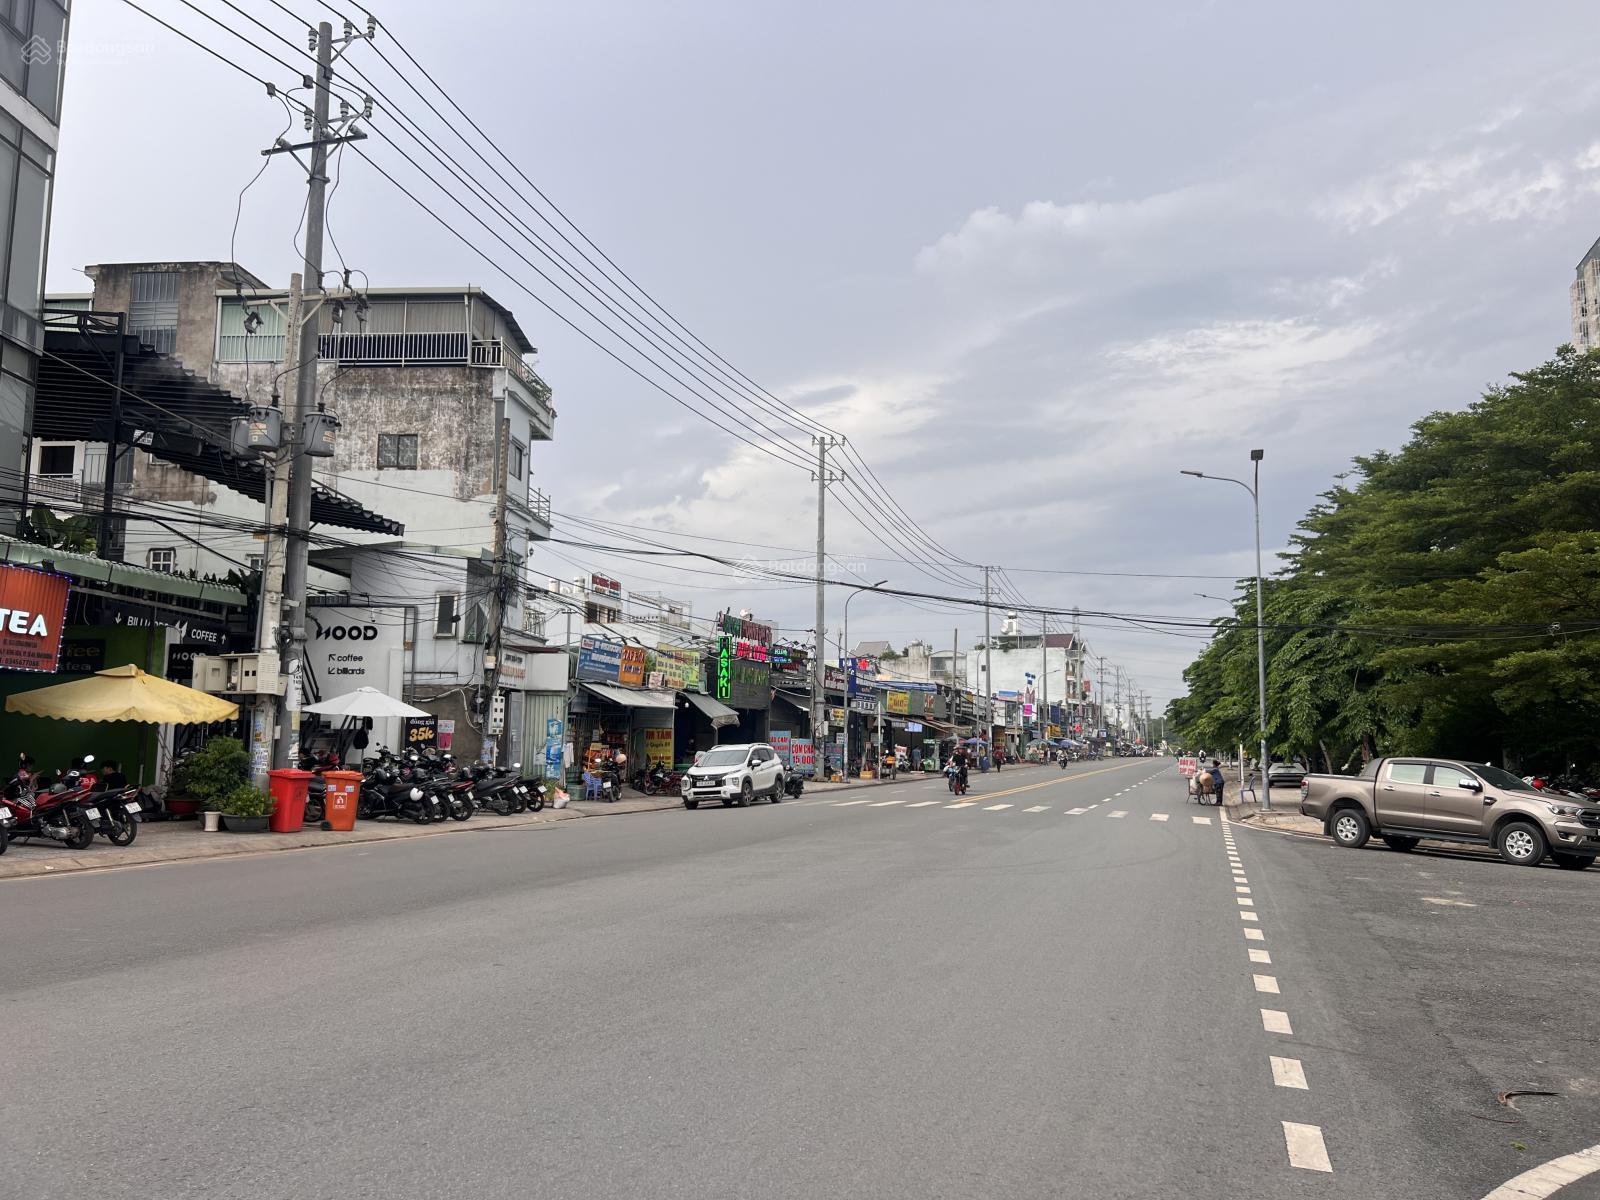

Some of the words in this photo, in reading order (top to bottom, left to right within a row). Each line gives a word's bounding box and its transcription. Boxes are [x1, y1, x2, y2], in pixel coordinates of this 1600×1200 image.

[191, 628, 218, 643] COFFEE
[337, 653, 364, 662] coffee
[409, 726, 435, 742] 35k
